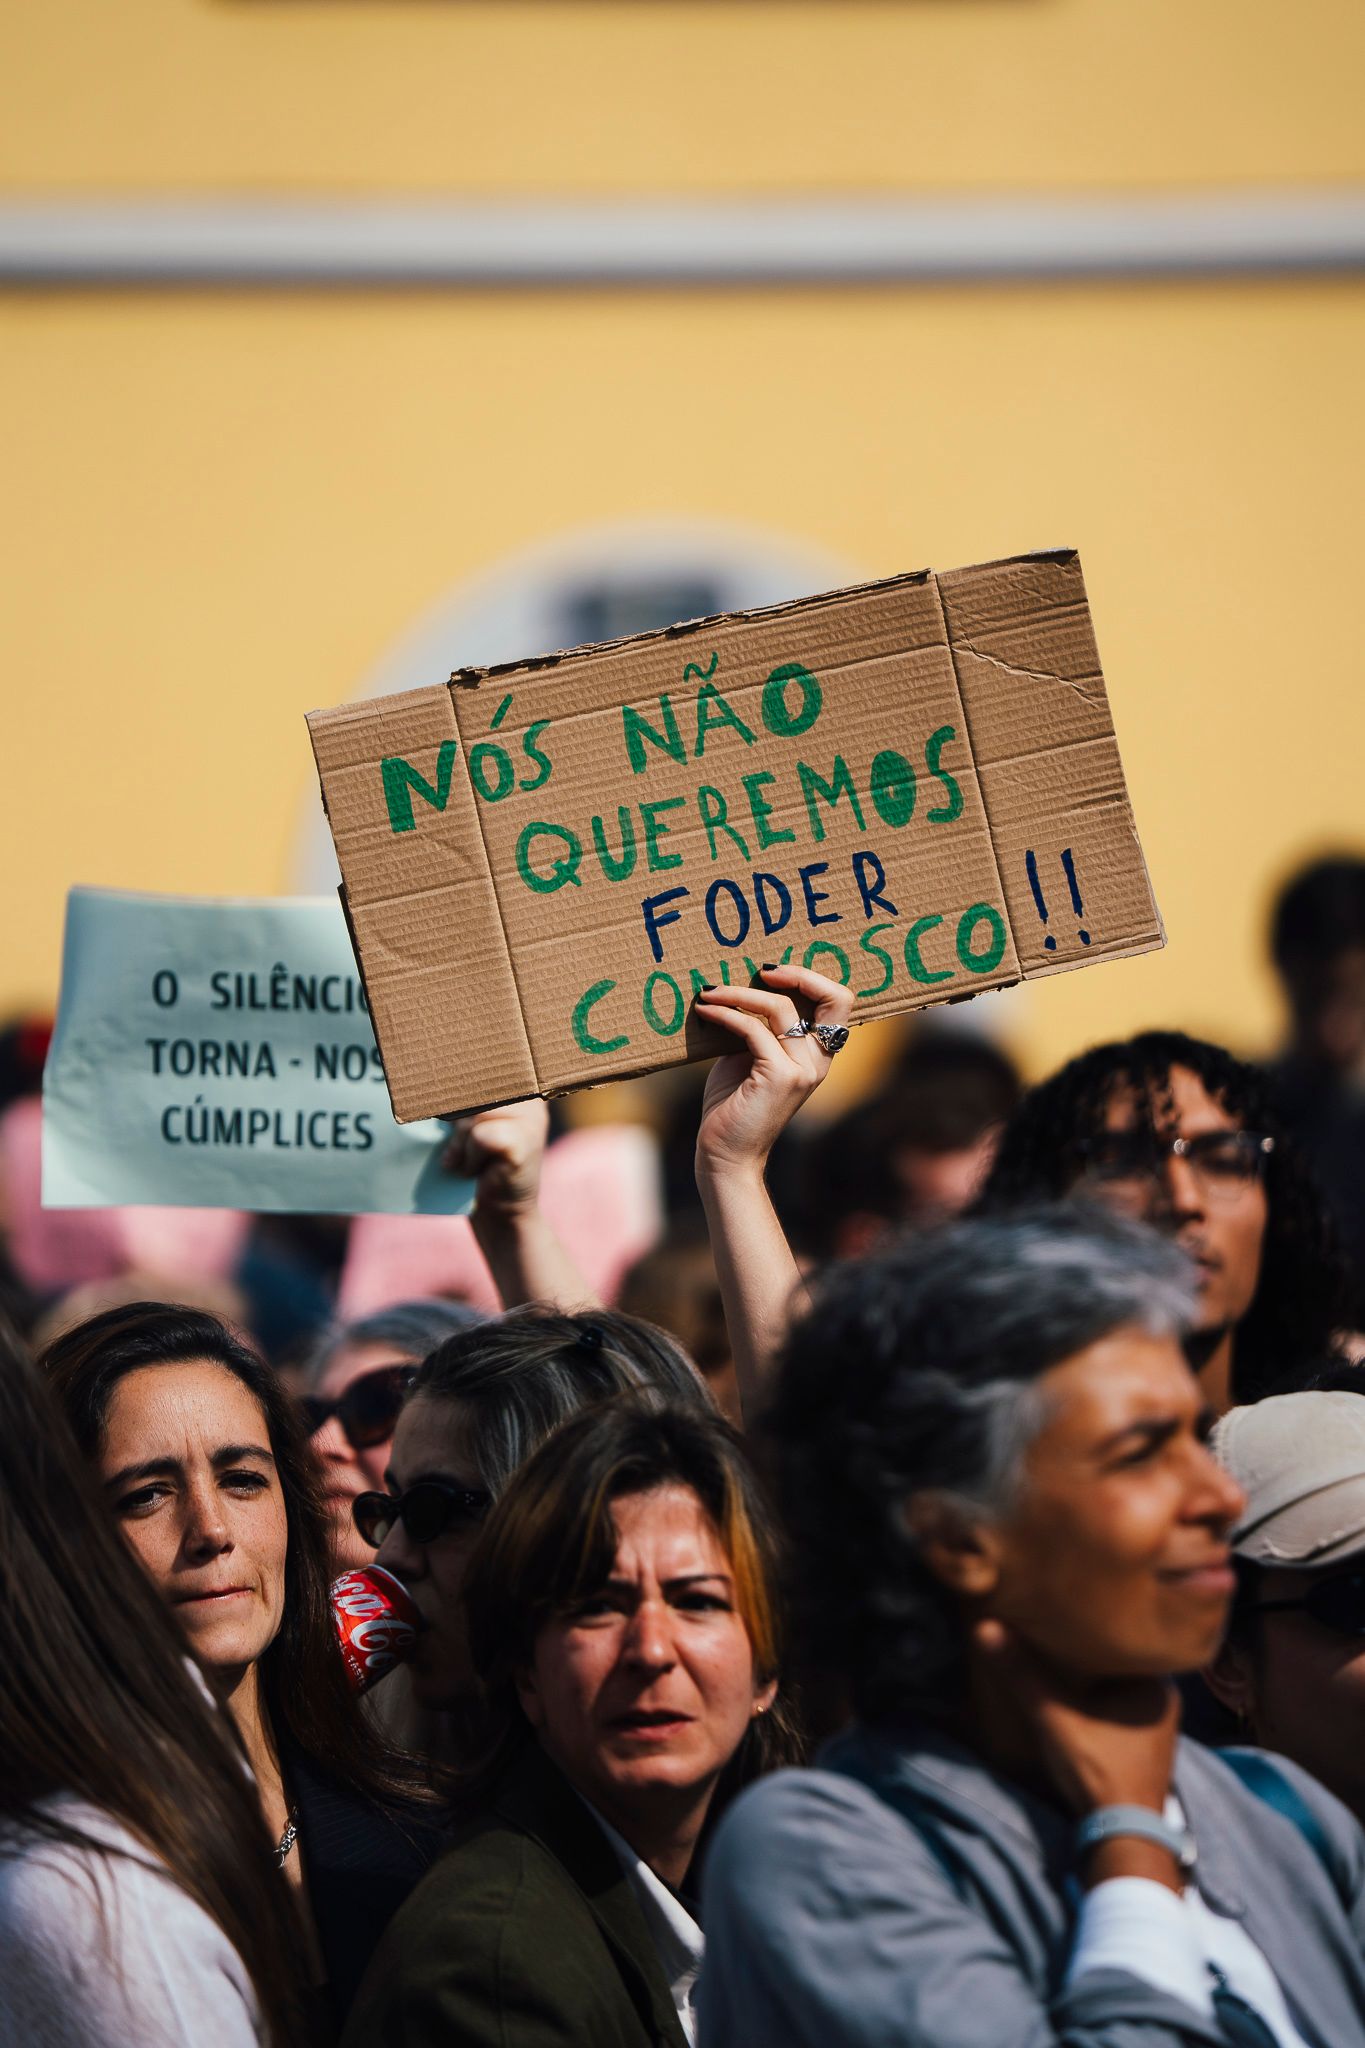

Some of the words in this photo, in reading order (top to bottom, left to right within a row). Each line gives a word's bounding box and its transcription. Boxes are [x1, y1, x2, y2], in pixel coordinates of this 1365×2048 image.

[381, 694, 552, 832] NÓS
[623, 652, 823, 774] NÃO
[516, 726, 964, 893] QUEREMOS
[642, 852, 897, 962] FODER
[1026, 849, 1092, 951] !!
[152, 969, 179, 1008] O
[146, 1038, 277, 1079] TORNA
[160, 1095, 375, 1151] CÚMPLICES
